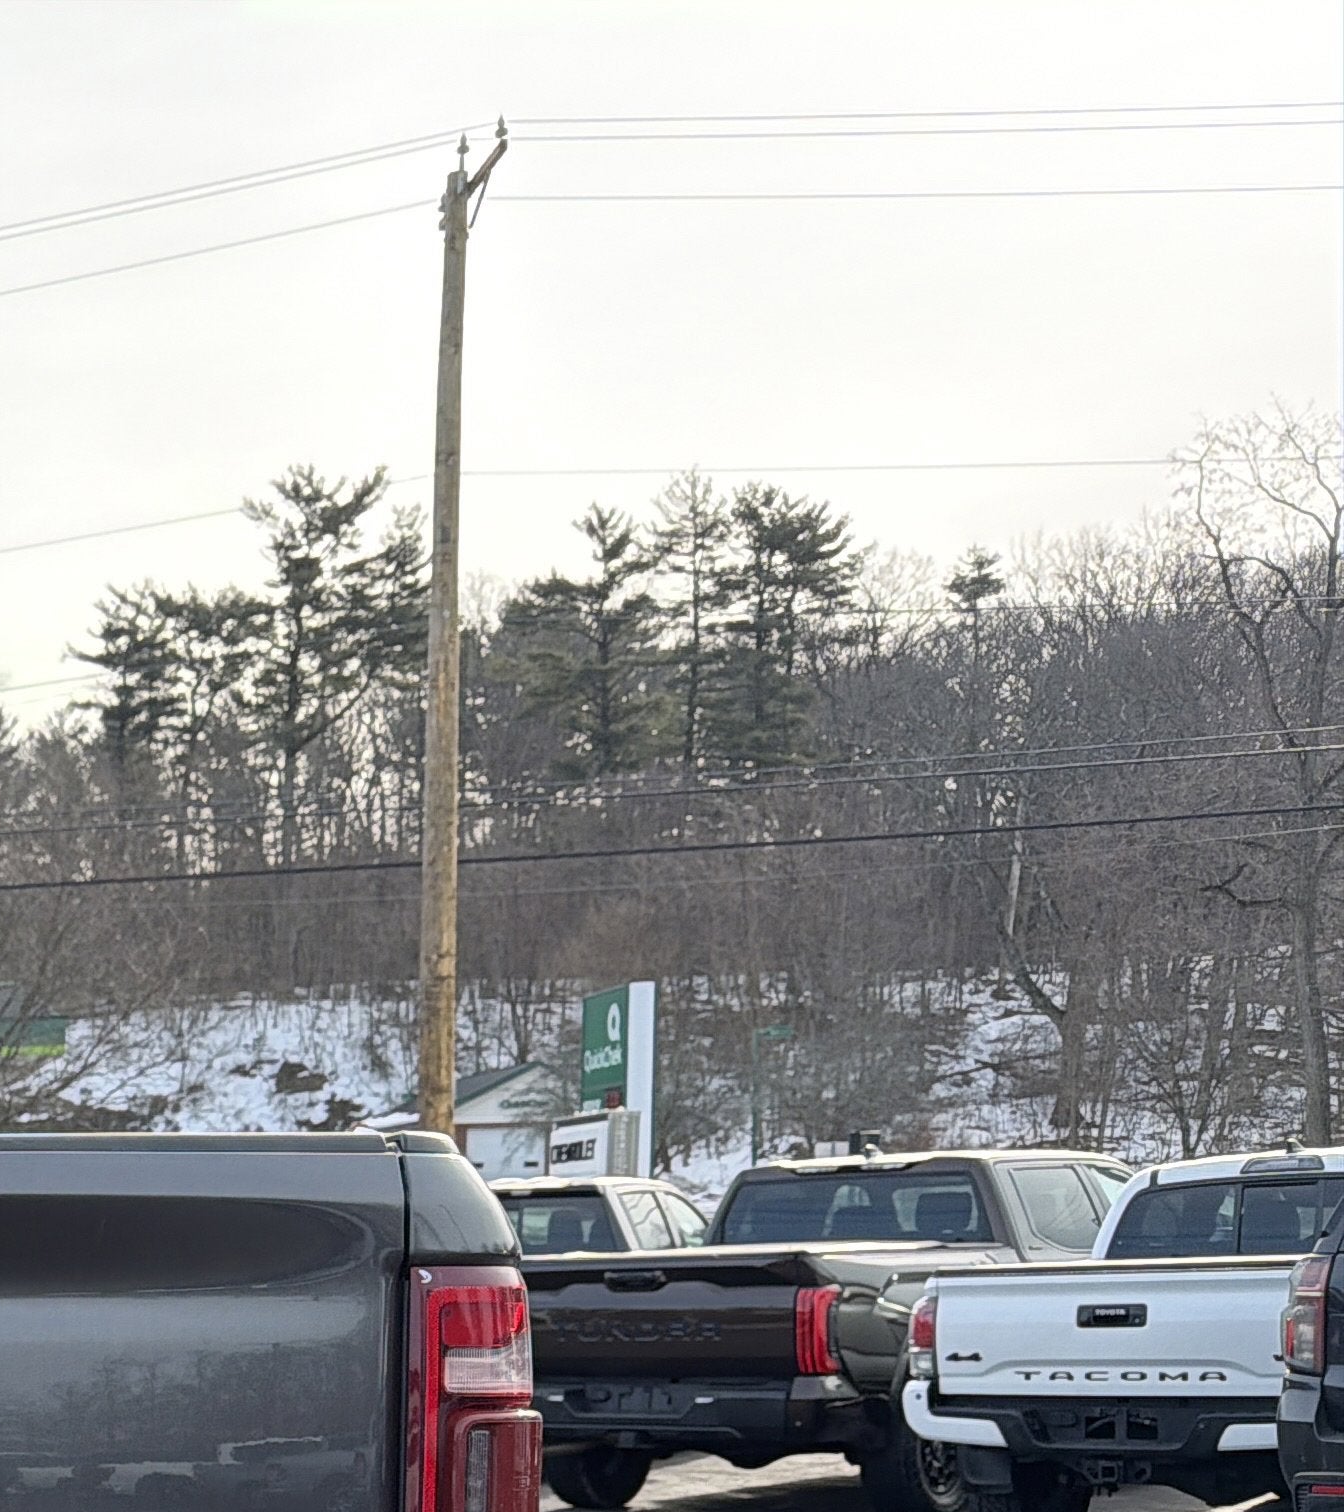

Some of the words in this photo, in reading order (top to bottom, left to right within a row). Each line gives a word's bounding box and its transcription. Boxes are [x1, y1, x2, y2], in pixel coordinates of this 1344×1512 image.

[1094, 1308, 1126, 1316] TOYOTA
[551, 1320, 721, 1342] TUNDRA
[1014, 1370, 1228, 1382] TACOMA
